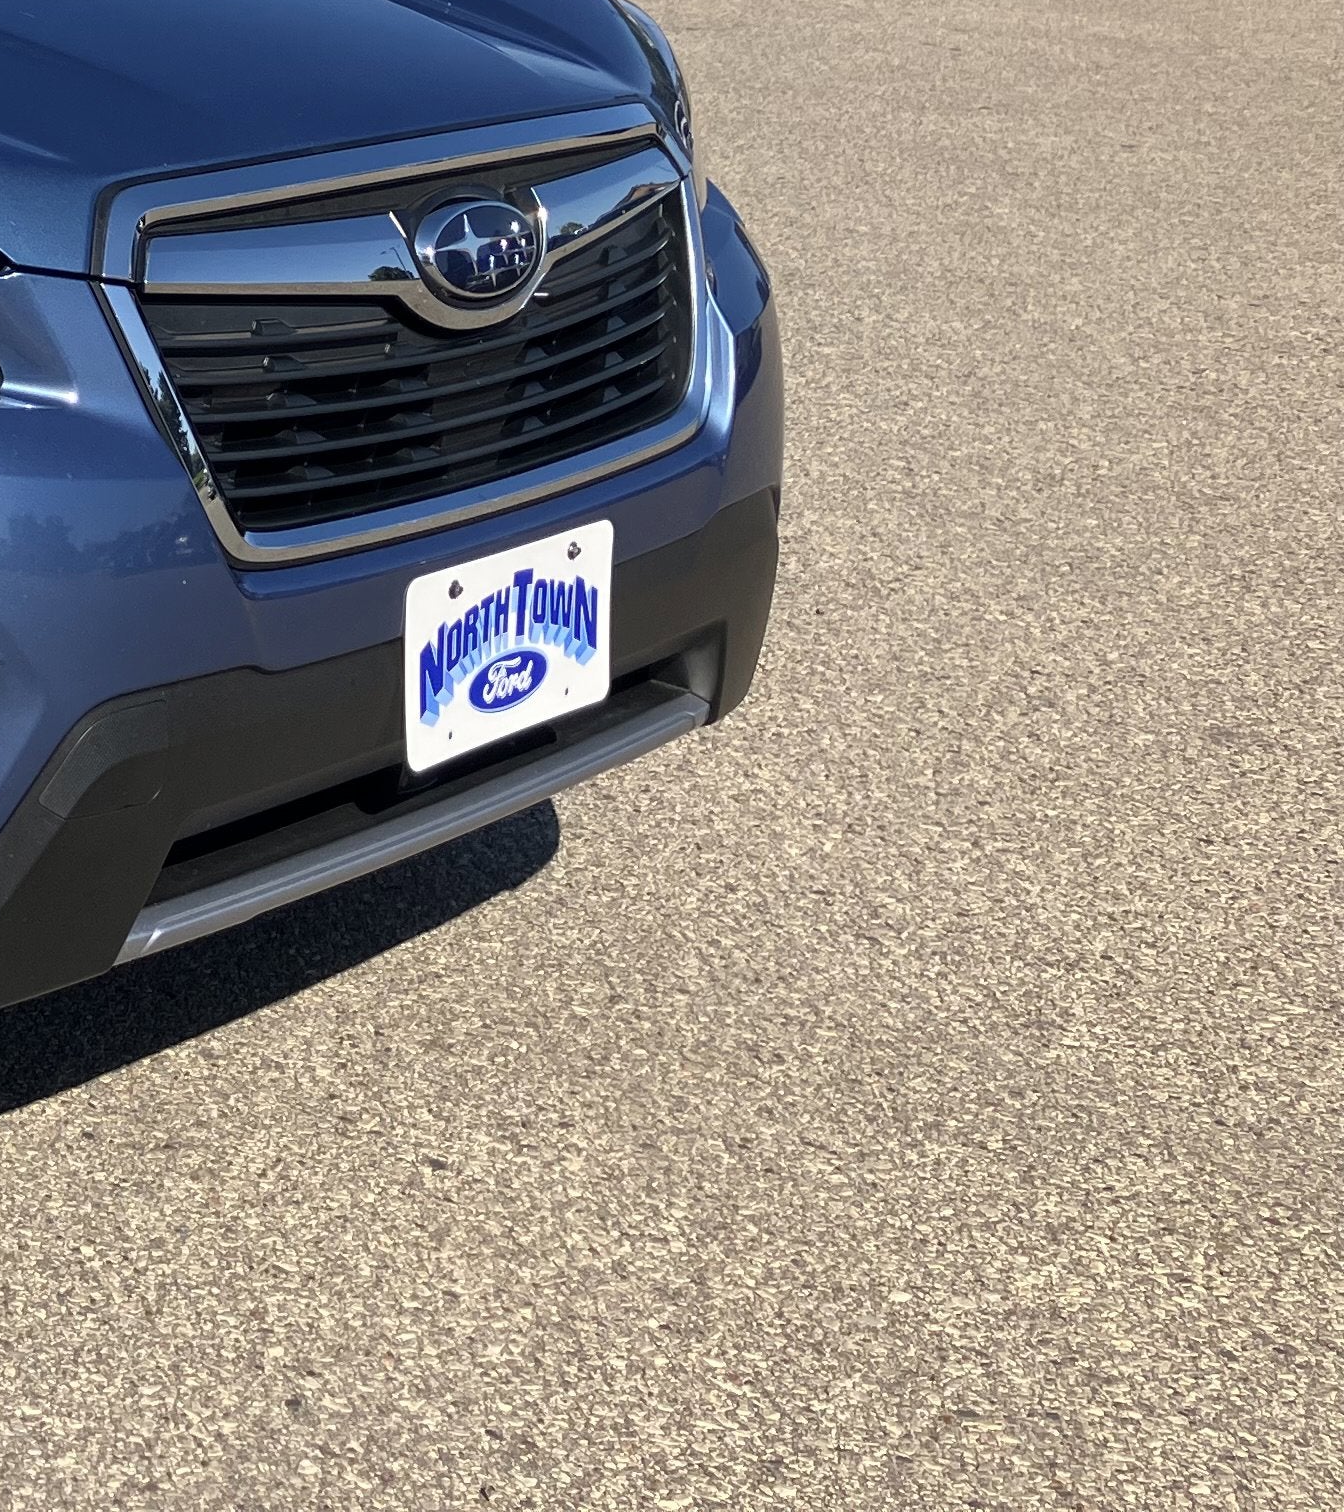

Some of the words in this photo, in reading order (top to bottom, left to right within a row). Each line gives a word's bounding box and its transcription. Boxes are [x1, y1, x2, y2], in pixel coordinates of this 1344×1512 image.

[420, 586, 511, 723] NORTH
[513, 568, 599, 658] TOWN
[483, 656, 534, 704] Ford
